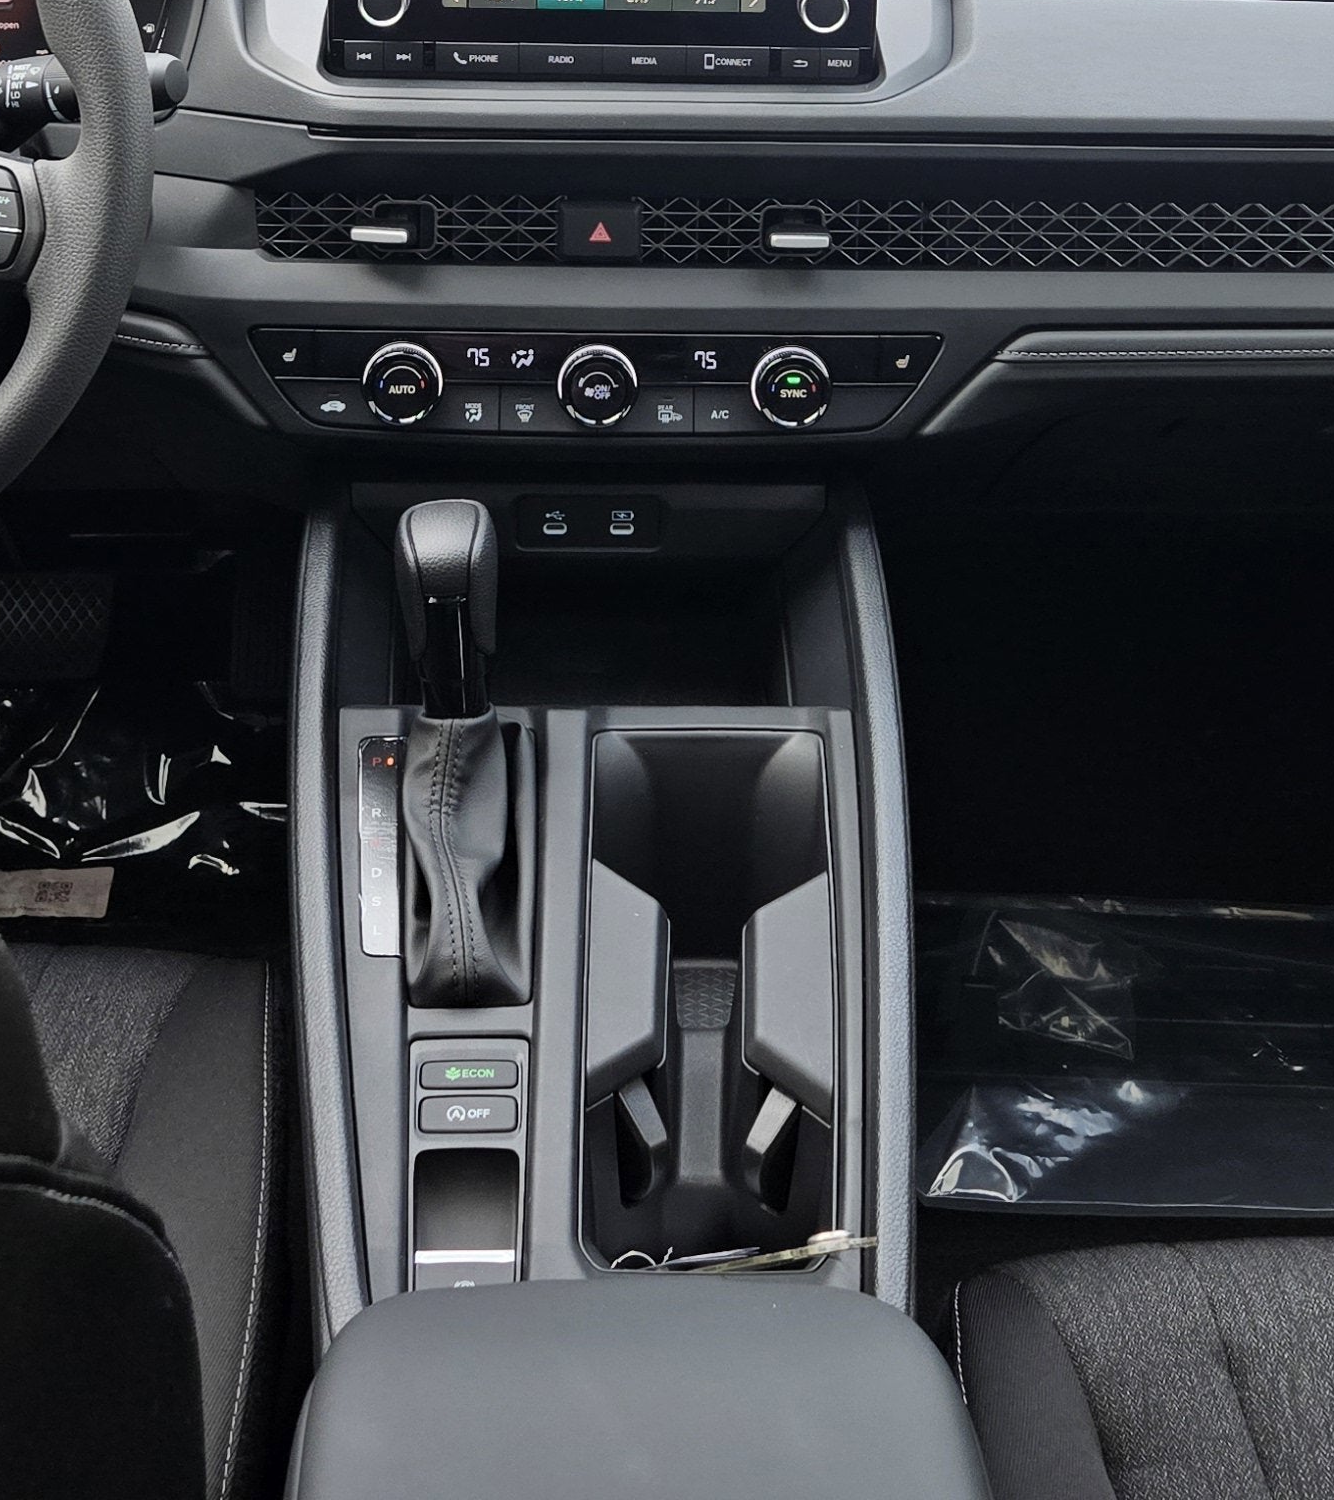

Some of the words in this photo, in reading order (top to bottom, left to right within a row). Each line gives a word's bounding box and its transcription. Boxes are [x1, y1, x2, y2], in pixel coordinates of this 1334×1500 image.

[469, 54, 498, 63] PHONE
[548, 55, 574, 64] RADIO
[631, 56, 657, 65] MEDIA
[715, 57, 753, 67] CONNECT
[827, 59, 852, 68] MENU
[11, 72, 26, 80] OFF
[11, 81, 23, 89] INT
[11, 91, 20, 100] LO
[467, 347, 490, 367] 75
[694, 350, 717, 369] 75
[388, 385, 416, 394] AUTO
[594, 385, 611, 393] ON/
[780, 389, 807, 398] SYNC
[594, 391, 611, 400] OFF
[711, 410, 729, 419] A/C
[372, 757, 382, 766] P
[372, 808, 382, 817] R
[372, 868, 382, 878] D
[372, 897, 381, 906] S
[373, 926, 382, 935] L
[461, 1068, 494, 1078] ECON
[467, 1108, 491, 1118] OFF
